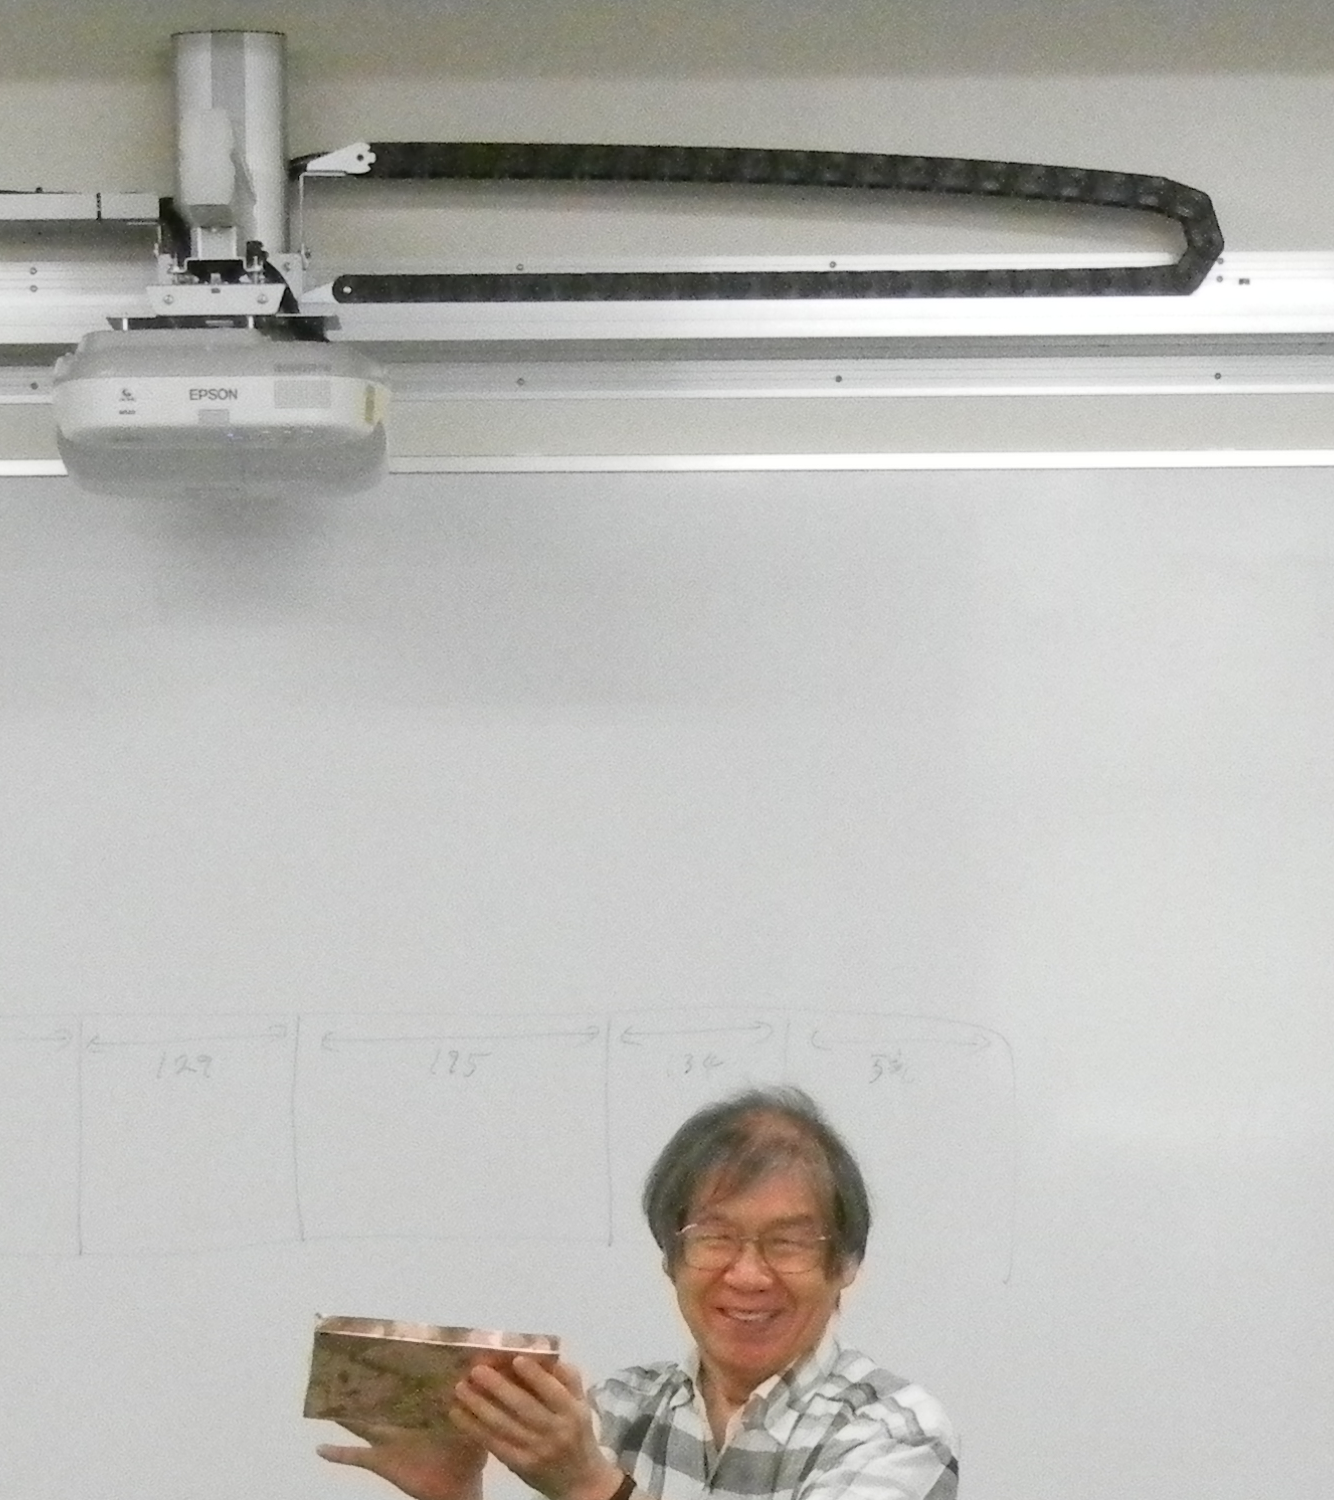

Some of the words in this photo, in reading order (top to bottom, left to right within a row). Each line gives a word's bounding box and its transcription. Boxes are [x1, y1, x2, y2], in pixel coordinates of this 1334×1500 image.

[188, 387, 238, 401] EPSON
[155, 1050, 214, 1080] 129
[429, 1047, 493, 1079] 195
